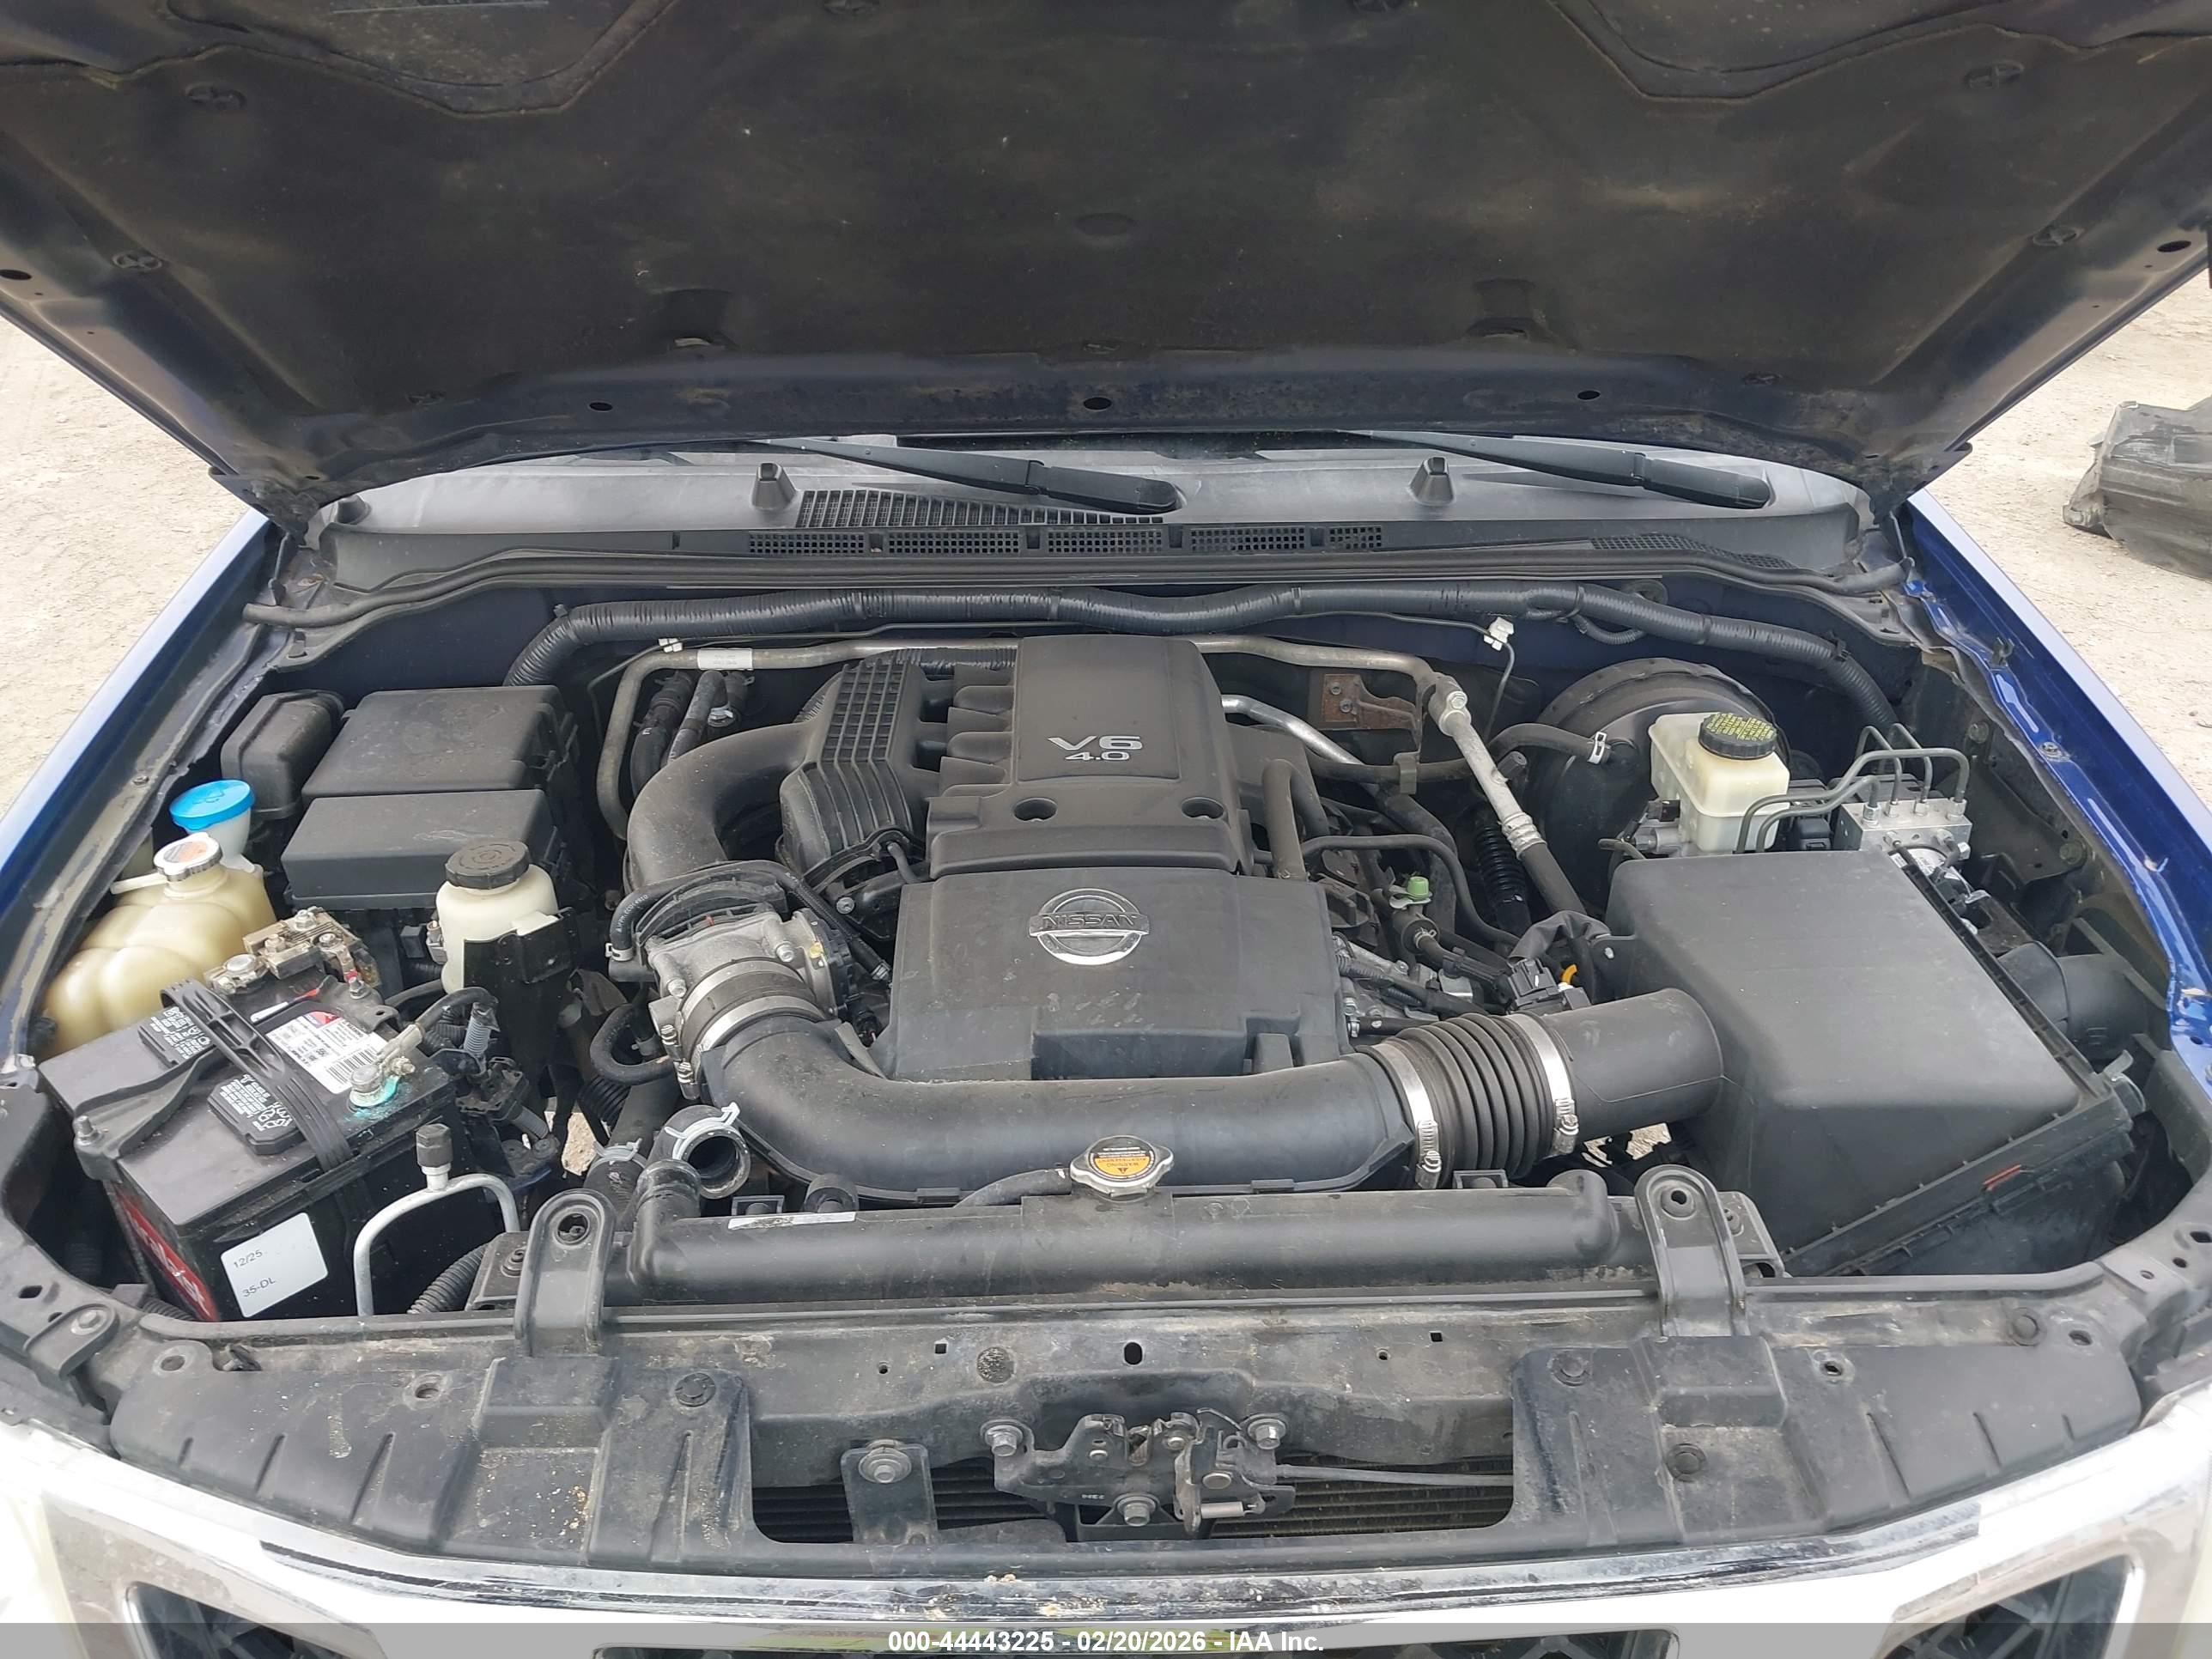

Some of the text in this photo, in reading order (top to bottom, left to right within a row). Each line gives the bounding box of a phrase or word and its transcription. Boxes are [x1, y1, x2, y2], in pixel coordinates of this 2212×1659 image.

[1047, 735, 1143, 750] V6
[1065, 750, 1130, 761] 4.0
[1042, 914, 1138, 928] NISSAN
[233, 1249, 263, 1268] 12/25
[241, 1277, 276, 1297] 35-DL
